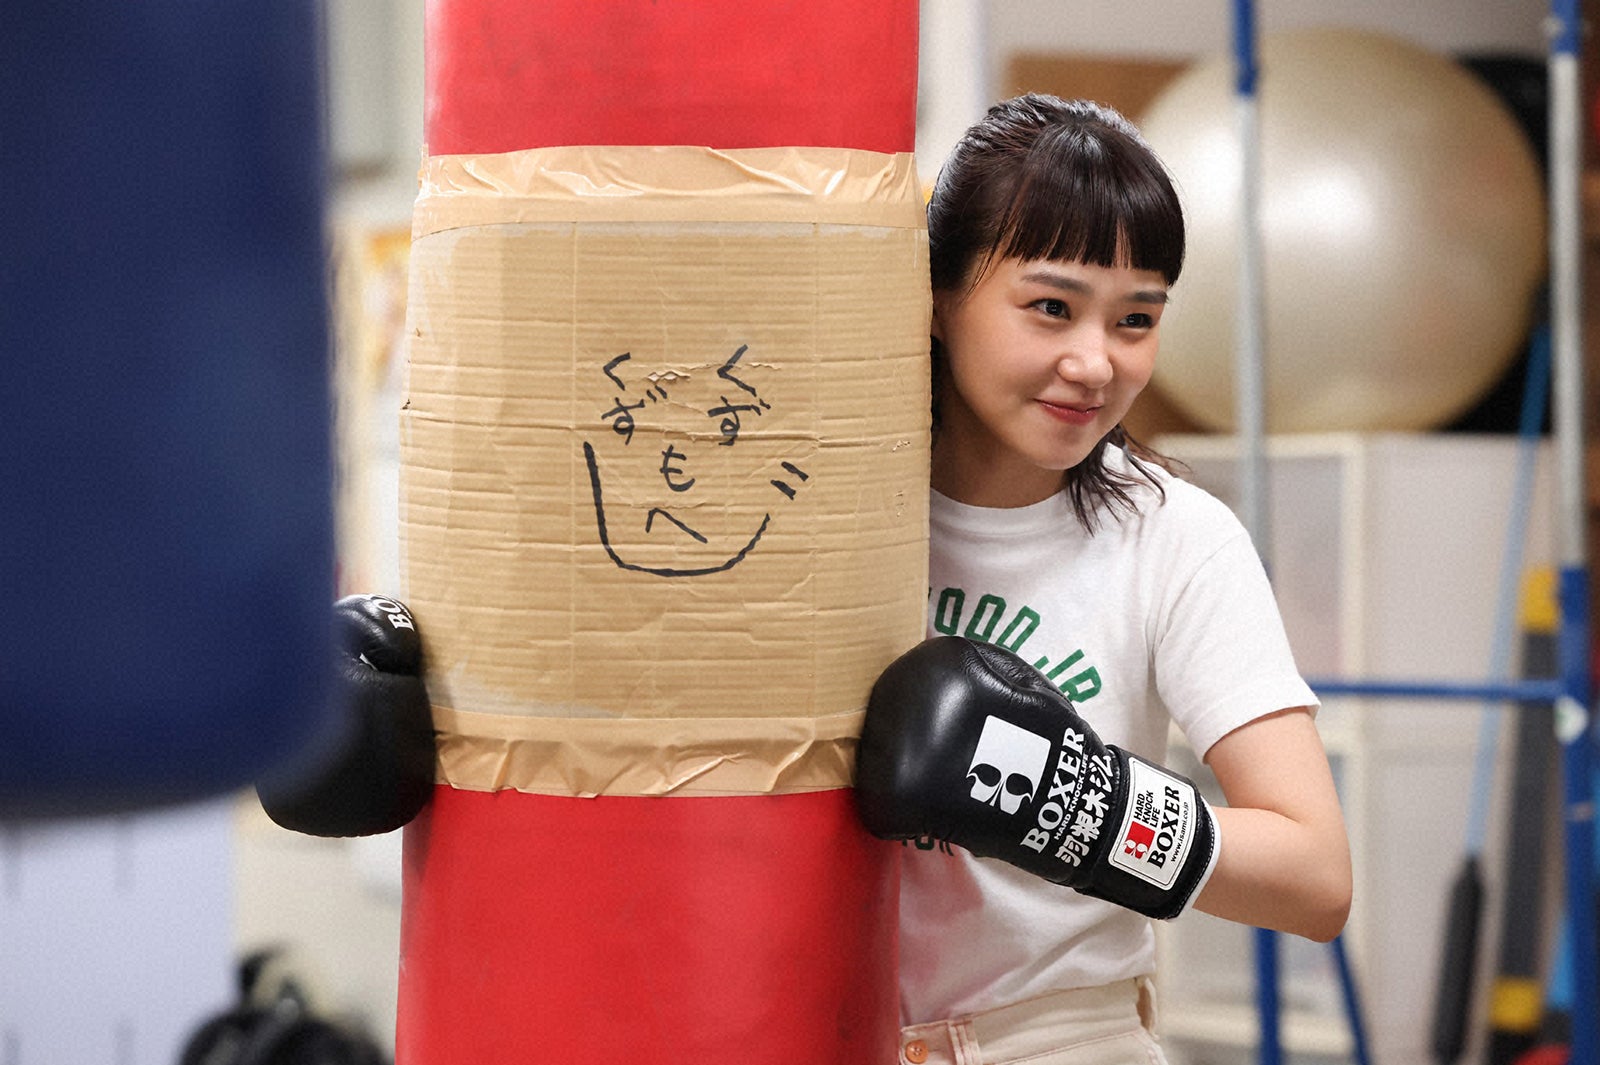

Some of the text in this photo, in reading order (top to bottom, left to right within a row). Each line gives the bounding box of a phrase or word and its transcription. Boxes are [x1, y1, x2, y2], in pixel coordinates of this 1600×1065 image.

[929, 587, 1041, 653] OOD
[1020, 727, 1085, 854] BOXER
[1053, 754, 1089, 840] HARD KNOCK LIFE
[1055, 755, 1113, 868] 羽根木ジム
[1133, 793, 1146, 820] HARD
[1141, 790, 1154, 825] KNOCK
[1149, 807, 1161, 828] LIFE
[1147, 785, 1180, 869] BOXER
[1170, 801, 1189, 862] www.isami.co.jp
